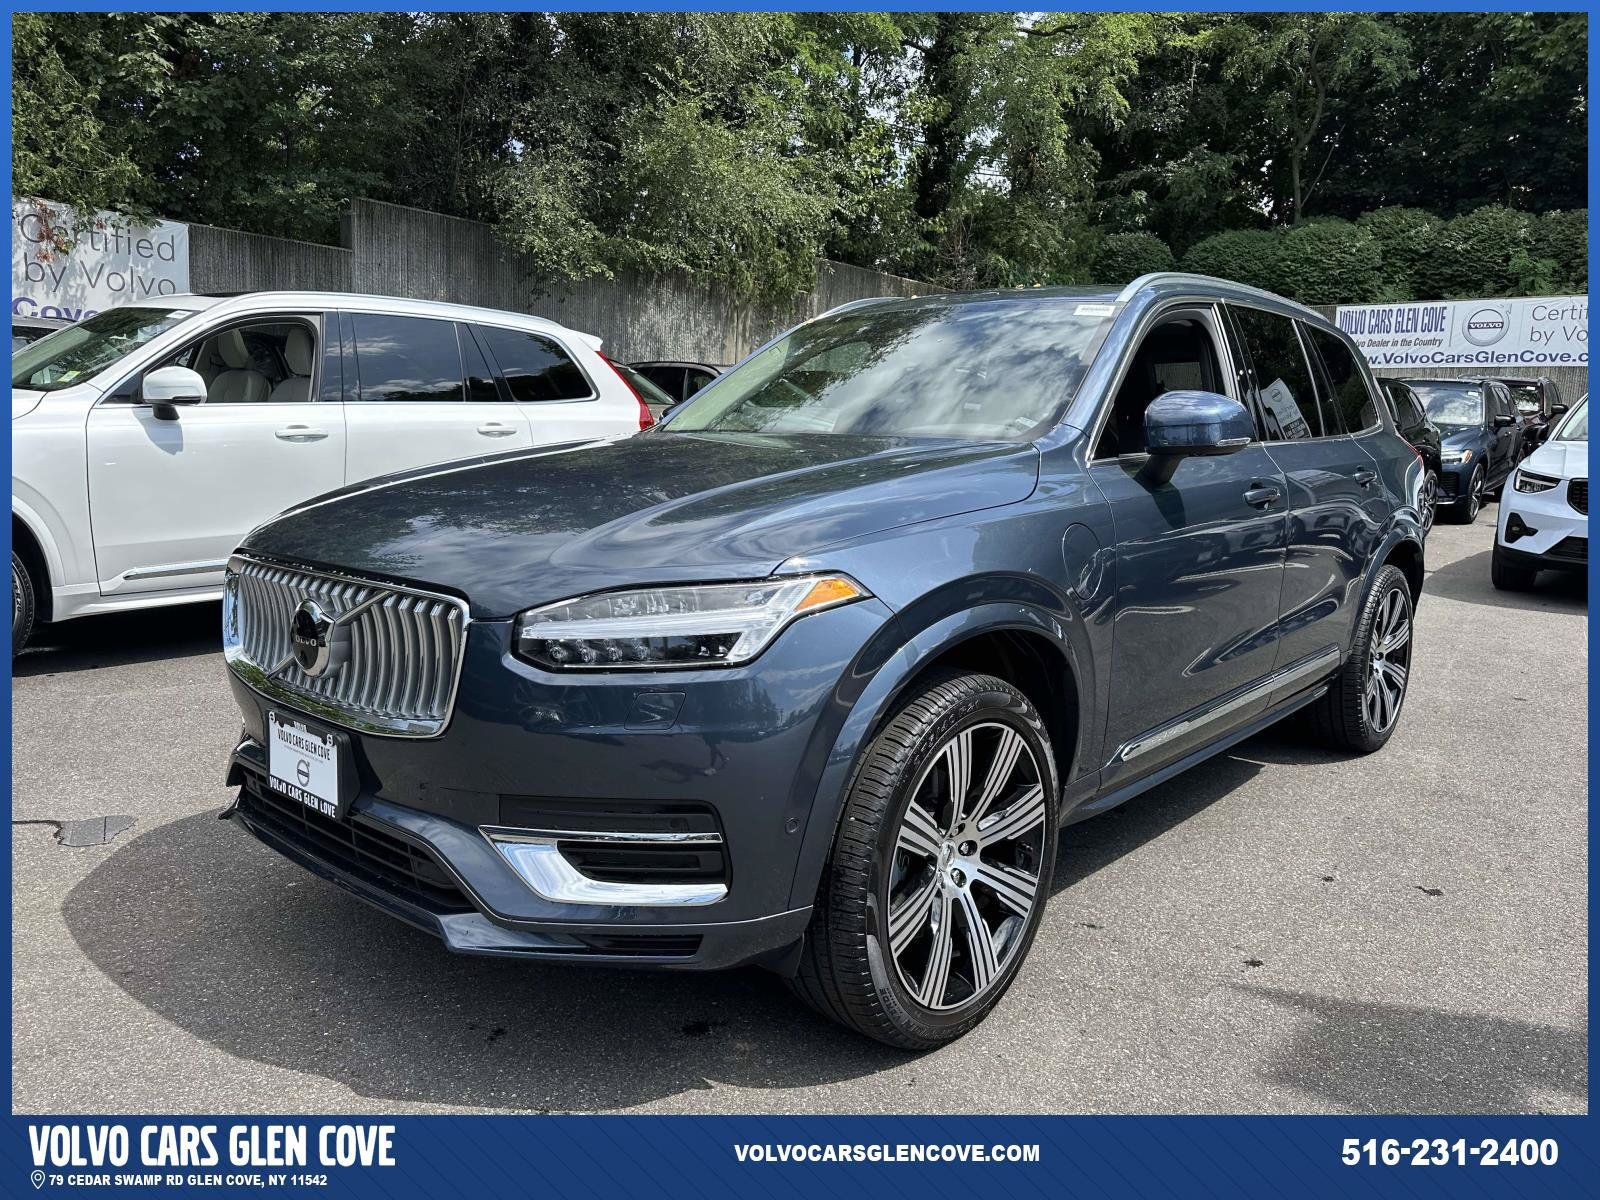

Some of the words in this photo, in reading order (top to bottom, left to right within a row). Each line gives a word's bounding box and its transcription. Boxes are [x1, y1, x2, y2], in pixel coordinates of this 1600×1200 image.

[24, 252, 66, 292] by
[80, 260, 176, 296] Volvo
[1340, 309, 1366, 335] VOLVO
[1367, 308, 1393, 335] CARS
[1394, 307, 1420, 334] GLEN
[1420, 306, 1447, 333] COVE
[1469, 321, 1503, 330] VOLVO
[1366, 338, 1390, 348] Dealer
[1391, 338, 1399, 347] in
[1400, 337, 1413, 347] the
[1413, 336, 1443, 348] Country
[1529, 325, 1555, 346] by
[278, 728, 292, 745] VOLVO
[292, 734, 304, 750] CARS
[305, 739, 317, 754] GLEN
[317, 744, 331, 761] COVE
[269, 774, 287, 795] VOLVO
[287, 785, 303, 802] CARS
[303, 792, 319, 810] GLEN
